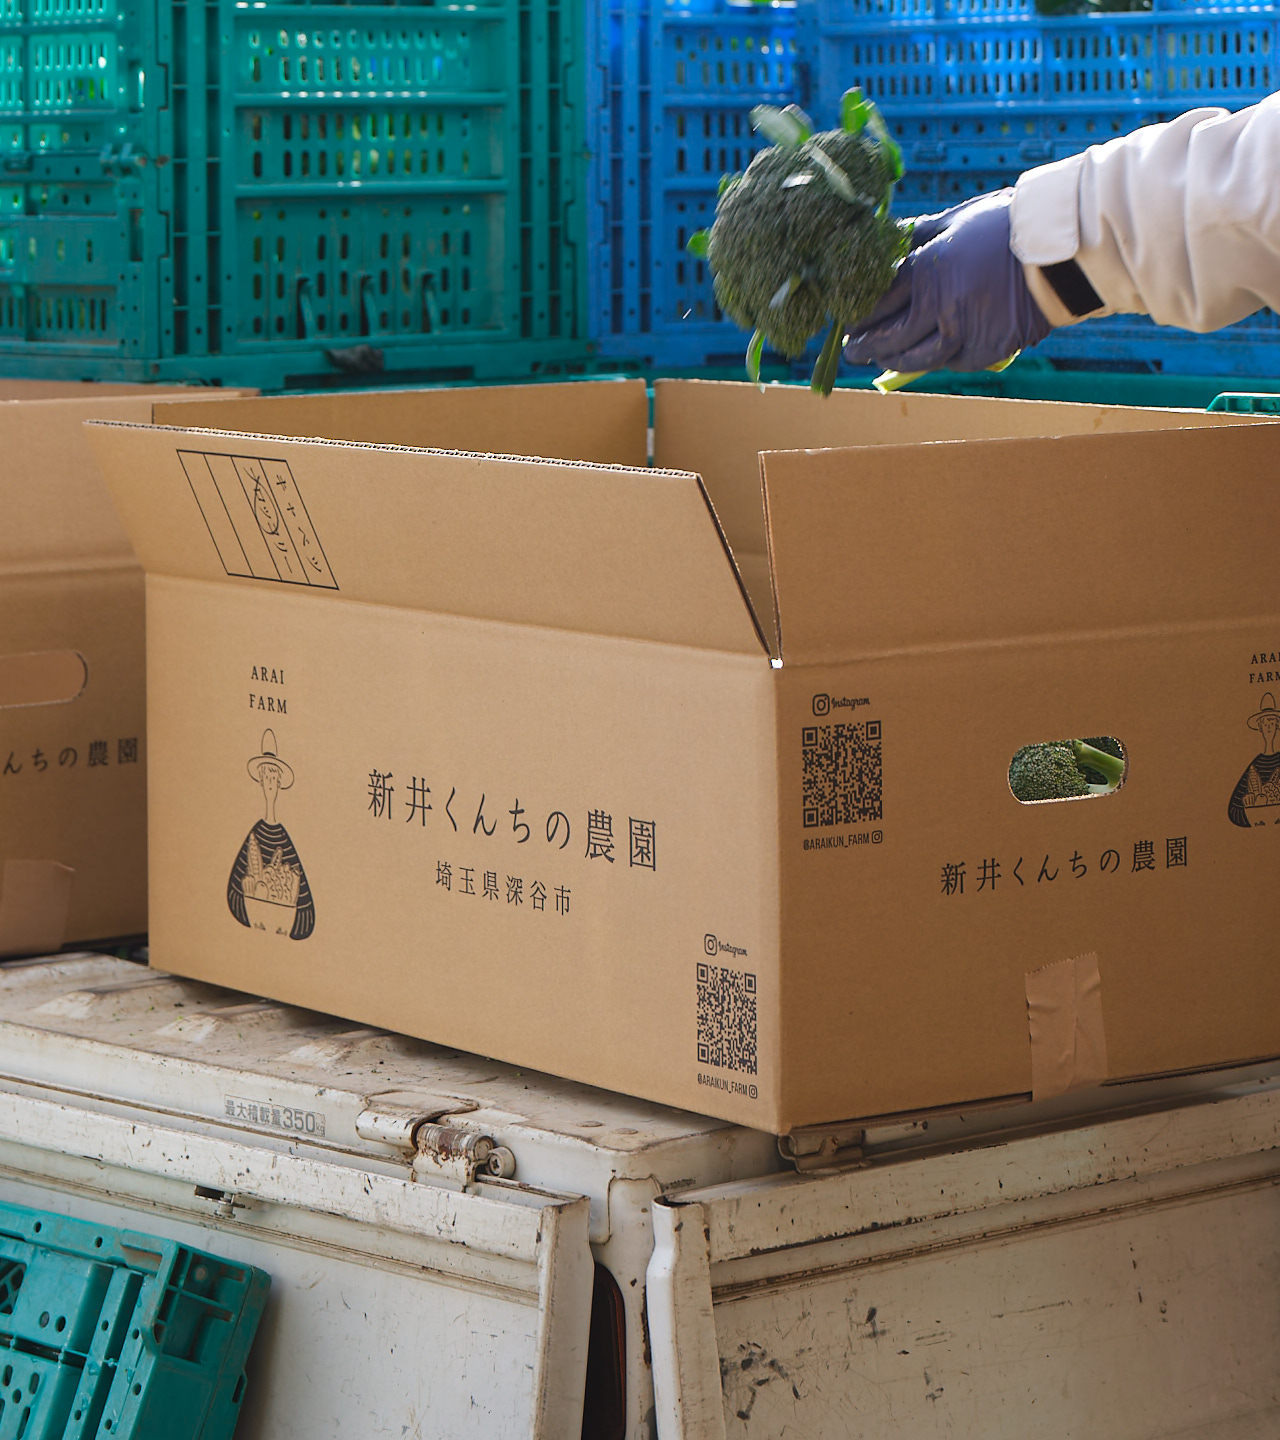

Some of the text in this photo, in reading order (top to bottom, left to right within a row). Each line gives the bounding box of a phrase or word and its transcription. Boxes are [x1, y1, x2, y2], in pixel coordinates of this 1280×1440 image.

[276, 474, 322, 573] キャベツ
[250, 665, 285, 685] ARAI
[248, 693, 288, 714] FARM
[831, 696, 871, 711] Instagram
[366, 767, 658, 872] 新井くんちの農園
[803, 832, 870, 851] @ARAIKUN_FARM
[940, 835, 1189, 897] 新井くんちの農園
[435, 859, 573, 916] 埼玉県深谷市
[718, 940, 748, 959] Instagram
